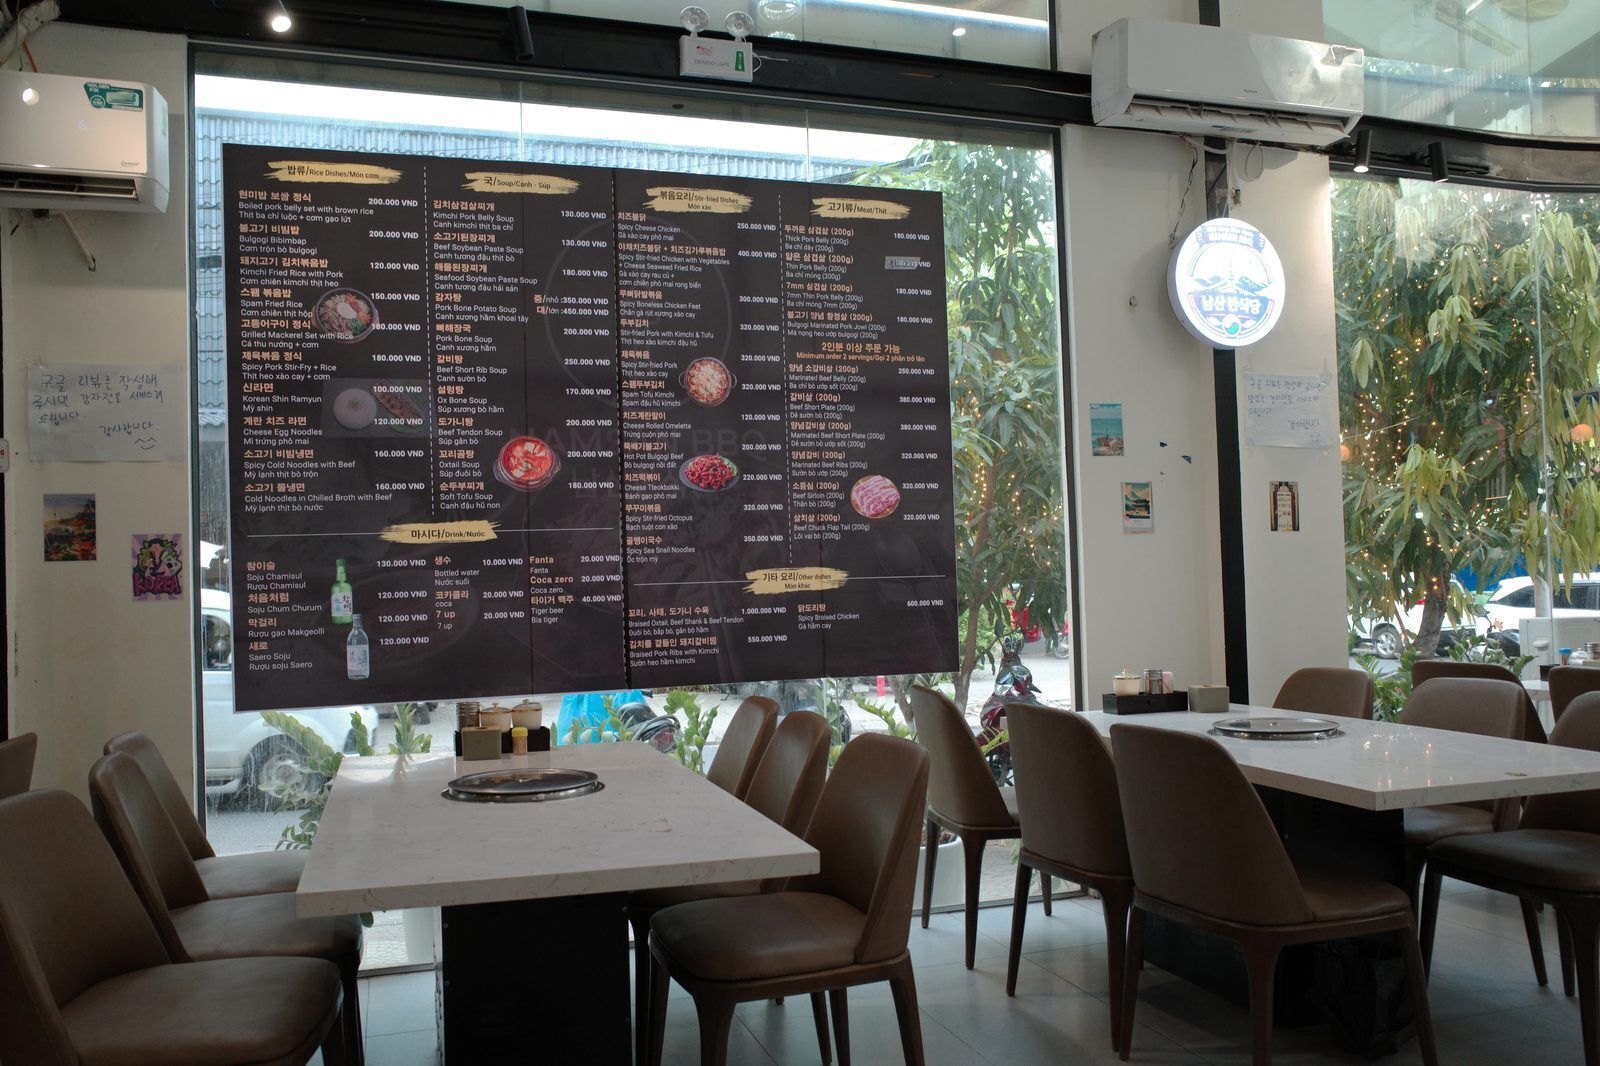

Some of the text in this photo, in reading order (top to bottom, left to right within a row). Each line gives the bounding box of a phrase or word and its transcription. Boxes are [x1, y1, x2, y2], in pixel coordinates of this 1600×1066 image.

[368, 197, 399, 206] 200.000
[238, 201, 262, 209] Boiled
[264, 202, 282, 211] pork
[284, 204, 301, 212] belly
[477, 214, 494, 222] Belly
[496, 214, 514, 223] Soup
[561, 210, 589, 218] 130.000
[617, 223, 632, 231] Spicy
[368, 230, 400, 238] 200.000
[239, 234, 306, 246] Bulgogi Bibimbap
[830, 237, 848, 246] (200g)
[369, 261, 401, 269] 120.000
[240, 299, 263, 307] Spam
[821, 342, 900, 353] 2인분 이상 주문 가능
[489, 366, 507, 374] Soup
[40, 374, 65, 392] 구글
[78, 374, 112, 391] 리뷰를
[242, 382, 273, 392] 신라면
[290, 395, 321, 404] Ramyun
[266, 416, 284, 425] 치즈
[288, 416, 306, 425] 라면
[274, 428, 288, 436] Egg
[474, 492, 493, 501] Soup
[529, 555, 553, 563] Fanta
[246, 573, 264, 582] Soju
[530, 575, 552, 584] Coca
[763, 572, 778, 581] 기타
[133, 571, 182, 596] KOREA
[798, 614, 813, 623] Spicy
[379, 637, 410, 645] 120.000
[273, 652, 290, 661] Soju
